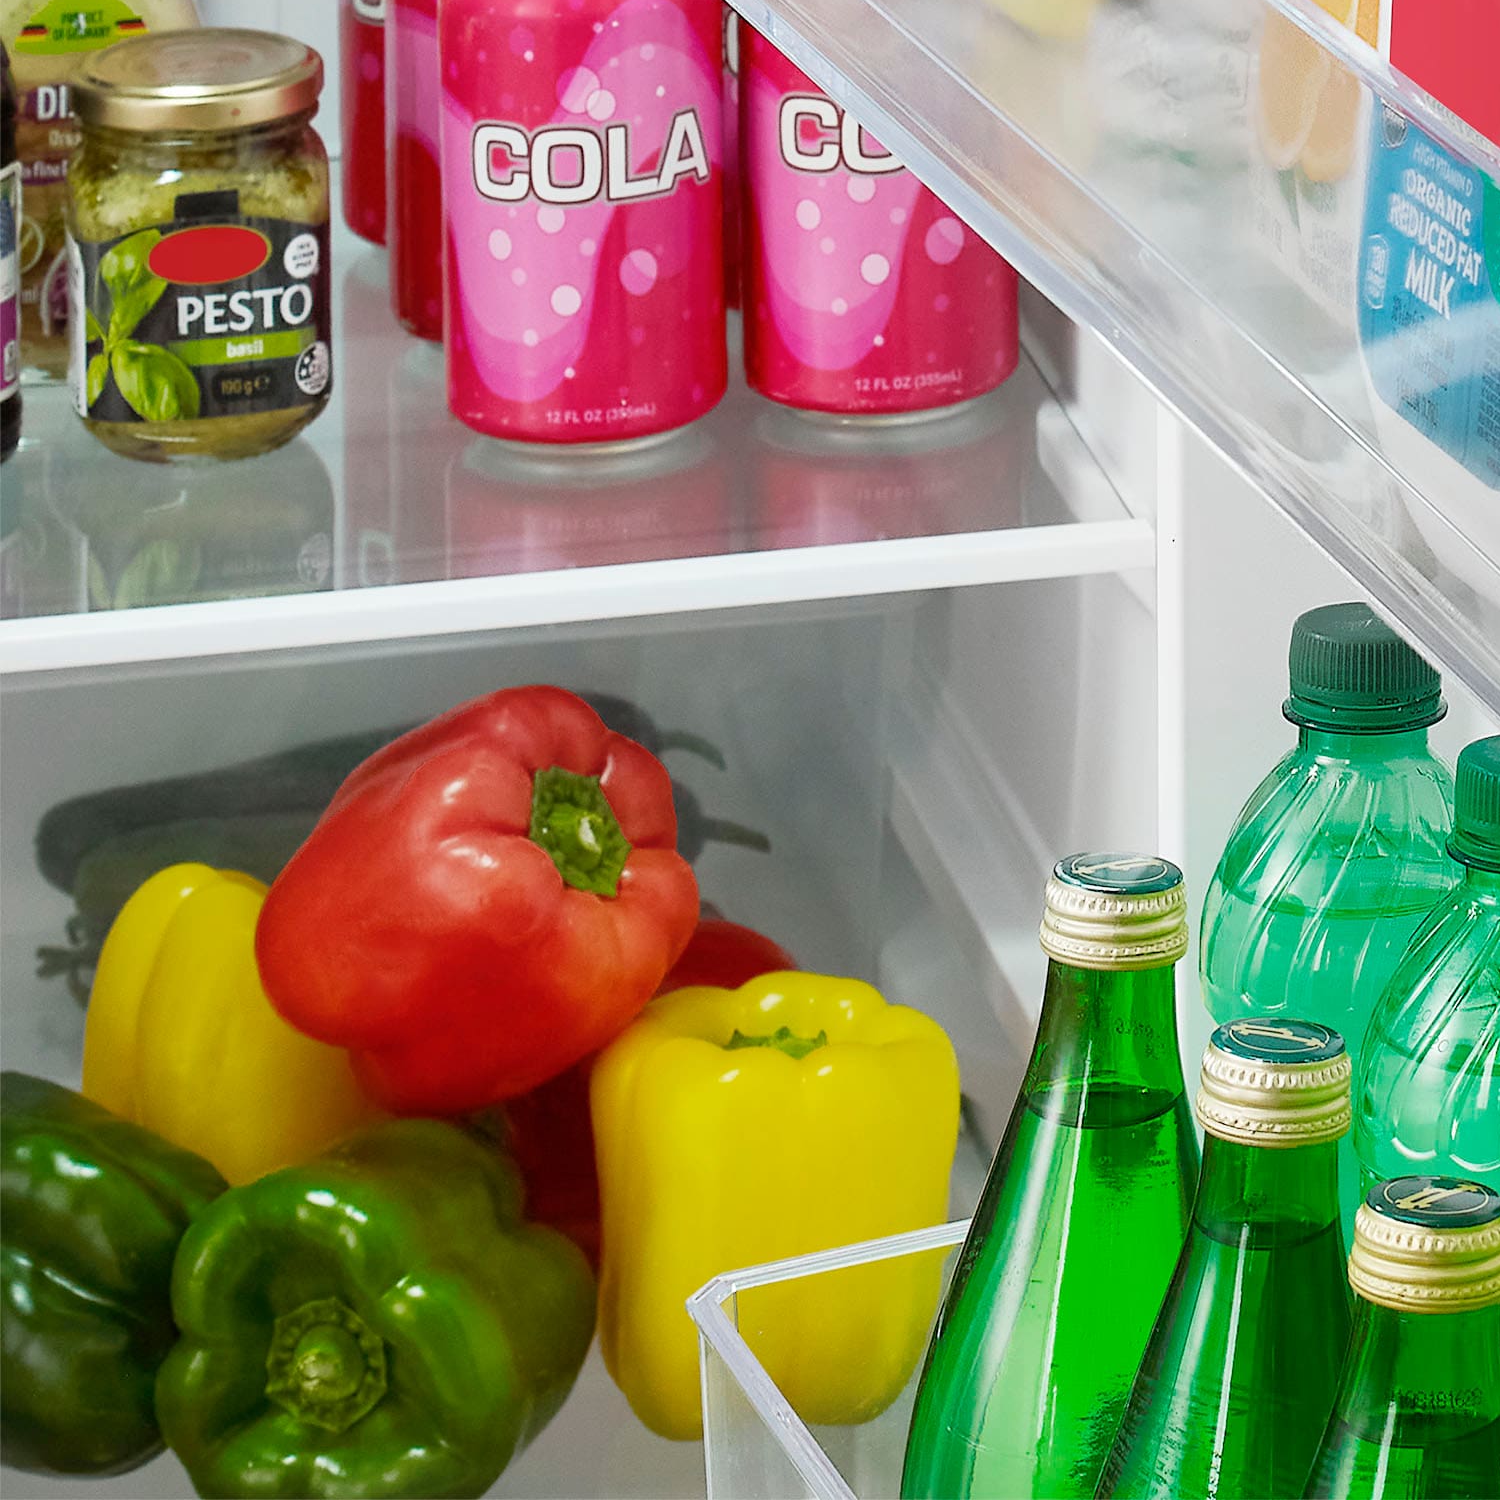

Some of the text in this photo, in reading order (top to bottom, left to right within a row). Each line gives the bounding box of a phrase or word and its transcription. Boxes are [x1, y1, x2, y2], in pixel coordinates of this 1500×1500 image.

[472, 108, 710, 204] COLA
[1405, 168, 1472, 237] ORGANIC
[1465, 178, 1474, 197] D
[1389, 193, 1457, 267] REDUCED
[1456, 241, 1482, 286] FAT
[177, 283, 313, 335] PESTO
[1405, 247, 1456, 320] MILK
[226, 339, 264, 358] basil
[855, 378, 870, 391] 12
[874, 377, 889, 391] FL
[893, 376, 911, 390] OZ
[546, 410, 560, 424] 12
[563, 410, 579, 424] FL
[584, 409, 602, 422] OZ
